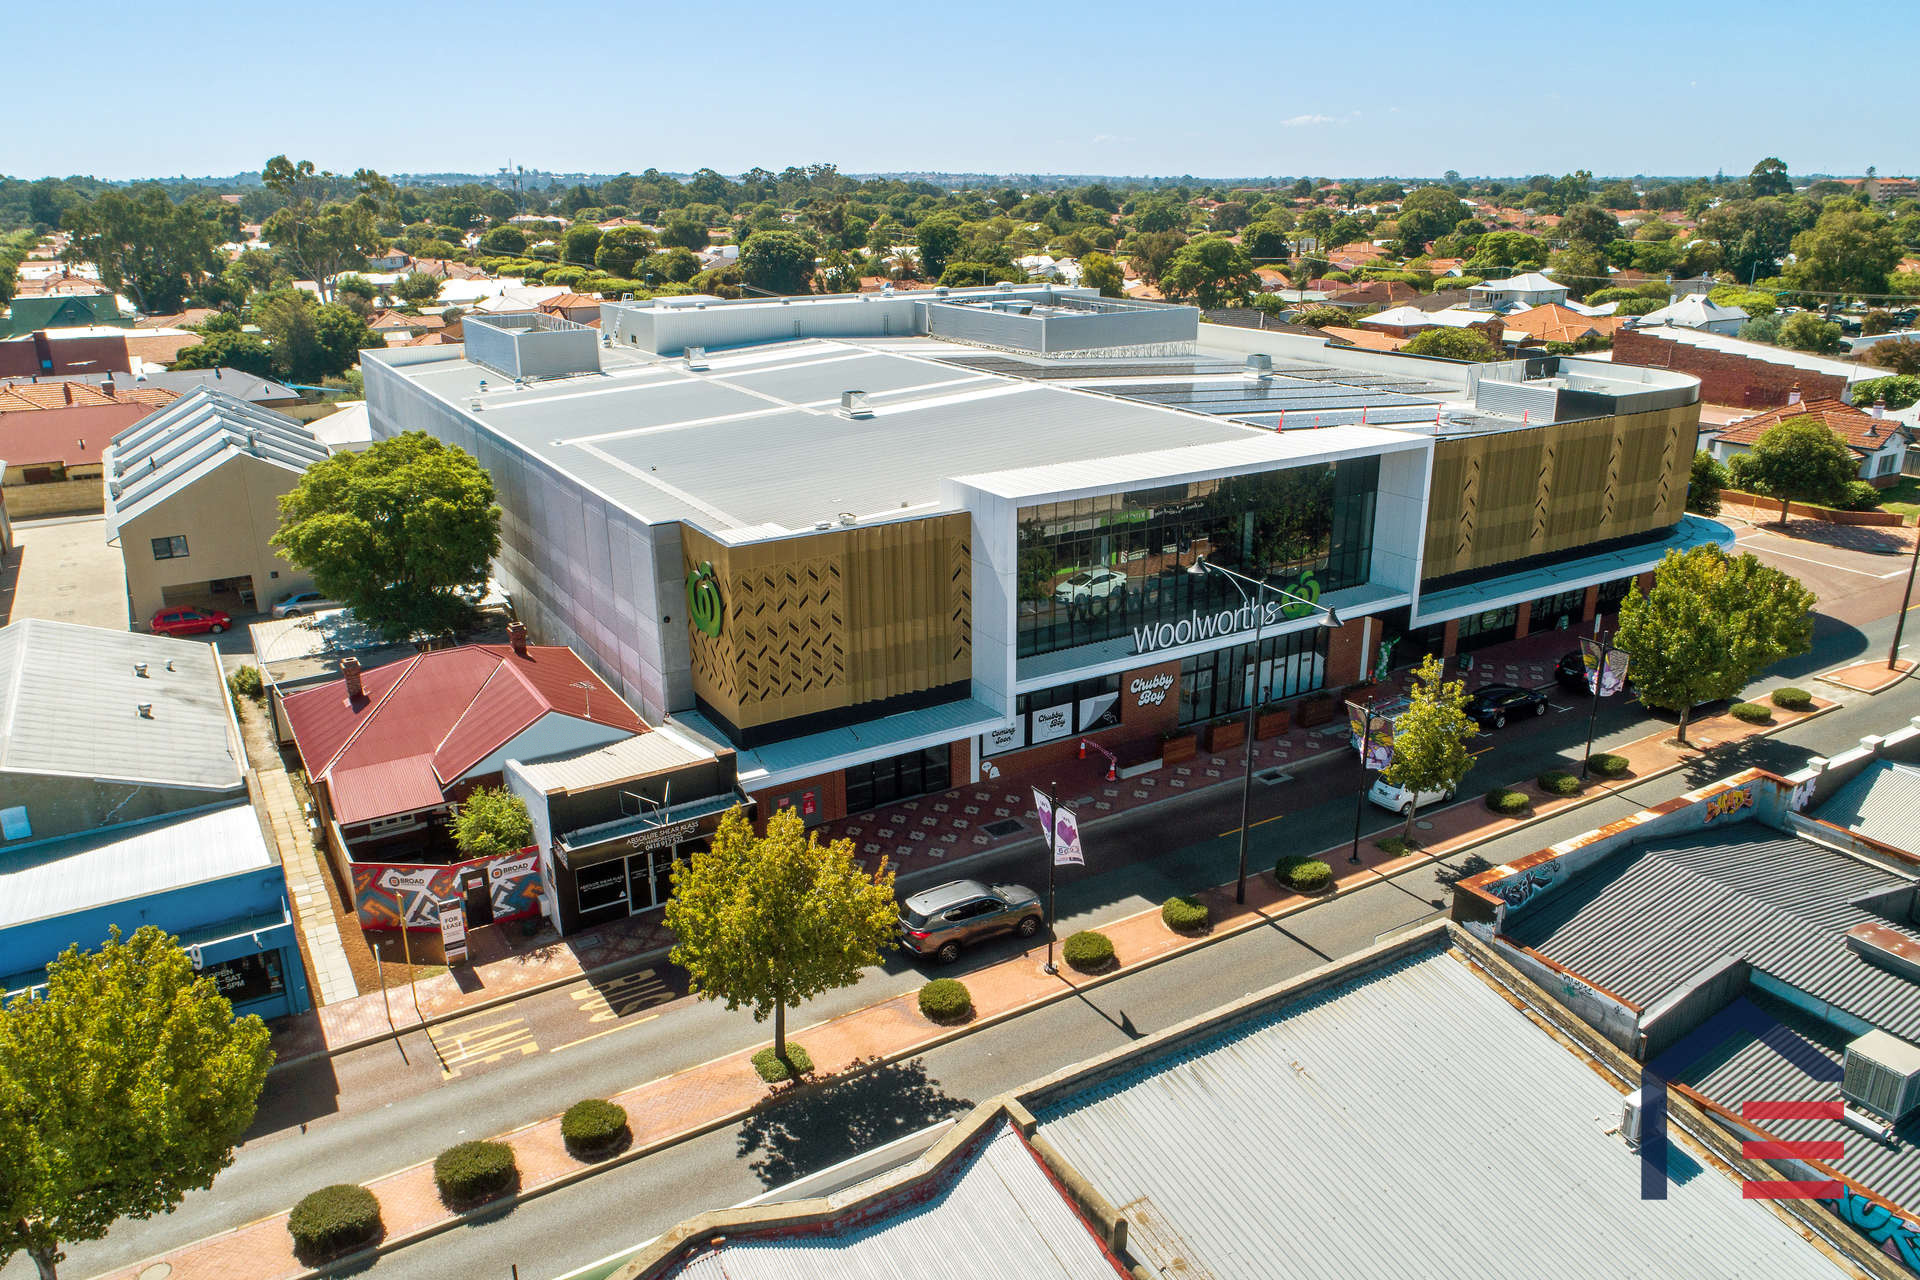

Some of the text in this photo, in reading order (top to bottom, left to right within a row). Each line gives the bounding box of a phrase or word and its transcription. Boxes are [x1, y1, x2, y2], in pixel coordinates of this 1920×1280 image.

[1133, 597, 1276, 654] Woolworths
[1130, 673, 1174, 694] Chubby
[1138, 690, 1166, 706] Boy
[1038, 711, 1064, 723] Chubby
[1049, 718, 1066, 728] Boy
[992, 727, 1016, 738] Coming
[995, 736, 1012, 745] Soon
[626, 821, 699, 846] ABSOLUTE SHEAR KLASS
[503, 863, 529, 874] BROAD
[444, 915, 459, 923] FOR
[442, 920, 463, 931] LEASE
[569, 968, 677, 1023] BUS
[427, 1002, 540, 1080] LANE
